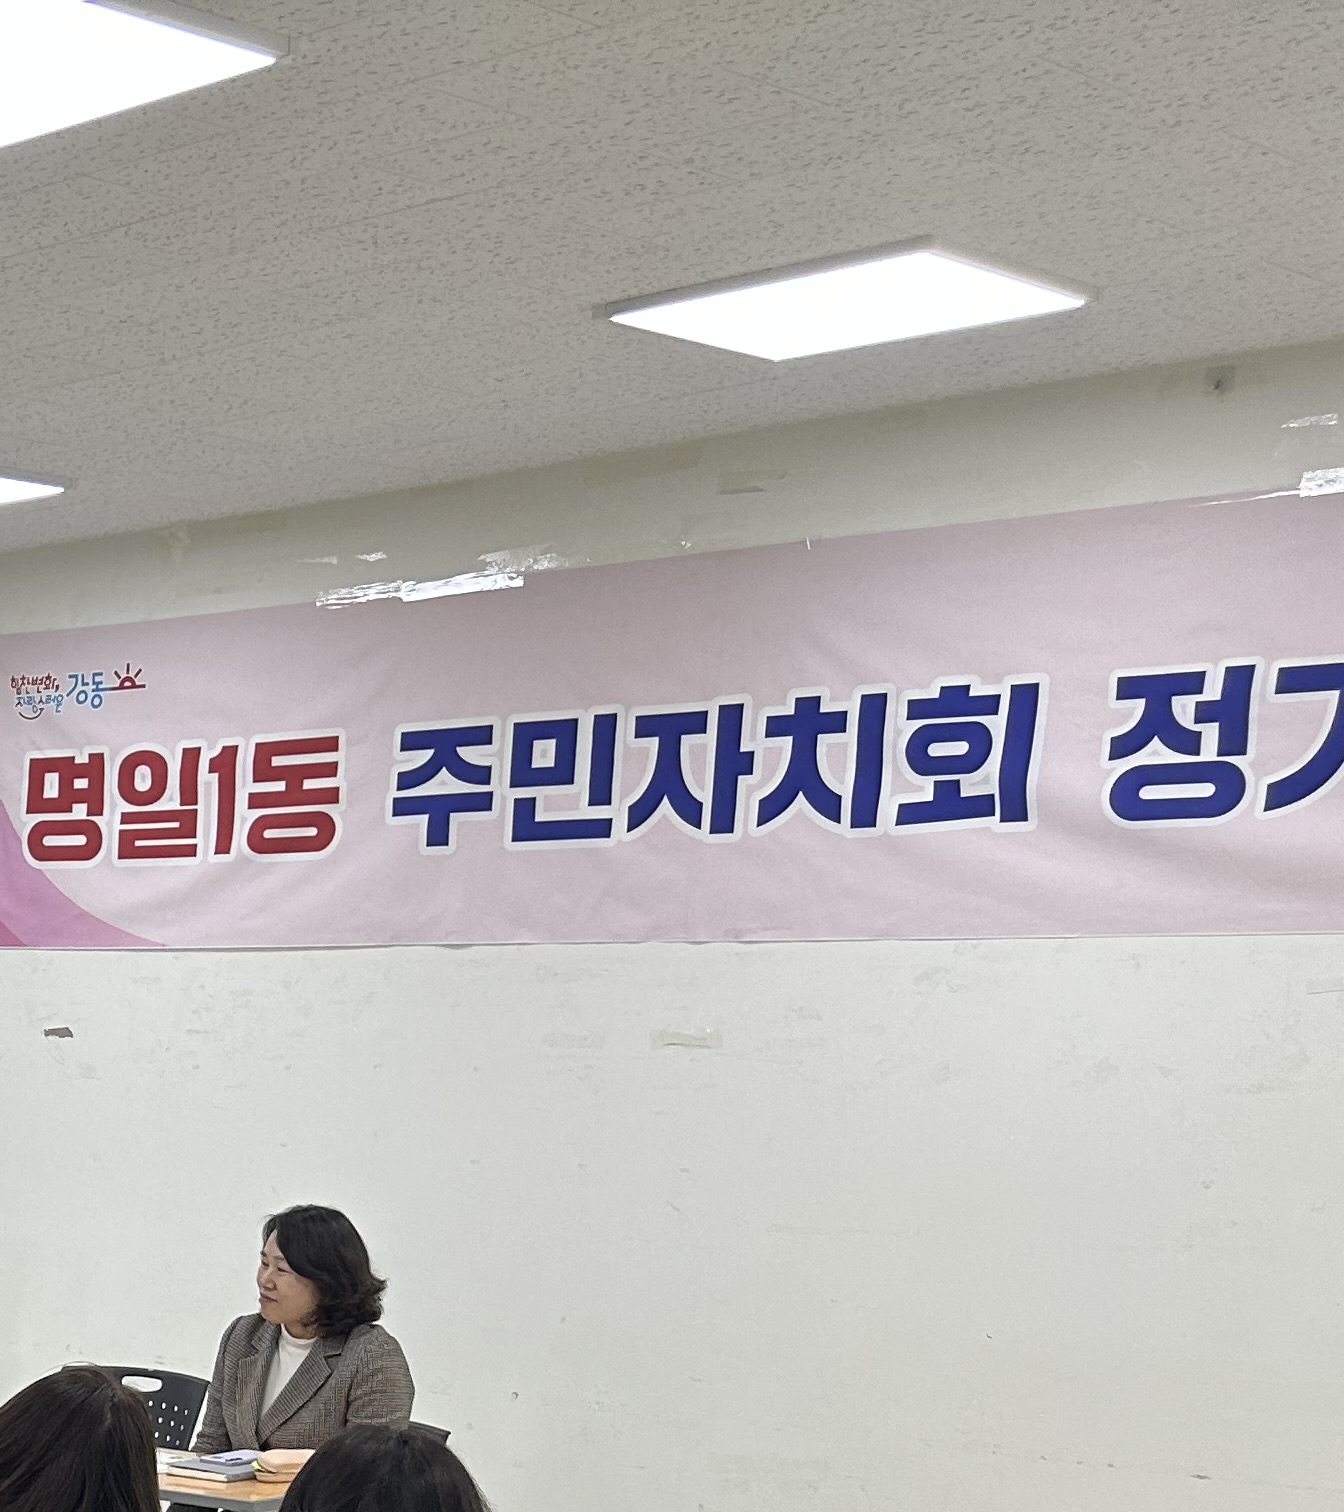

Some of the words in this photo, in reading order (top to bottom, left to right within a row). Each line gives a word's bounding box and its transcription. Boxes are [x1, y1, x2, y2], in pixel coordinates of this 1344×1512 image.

[66, 671, 105, 709] 강동
[25, 735, 341, 862] 명일1동
[391, 682, 1045, 849] 주민자치회
